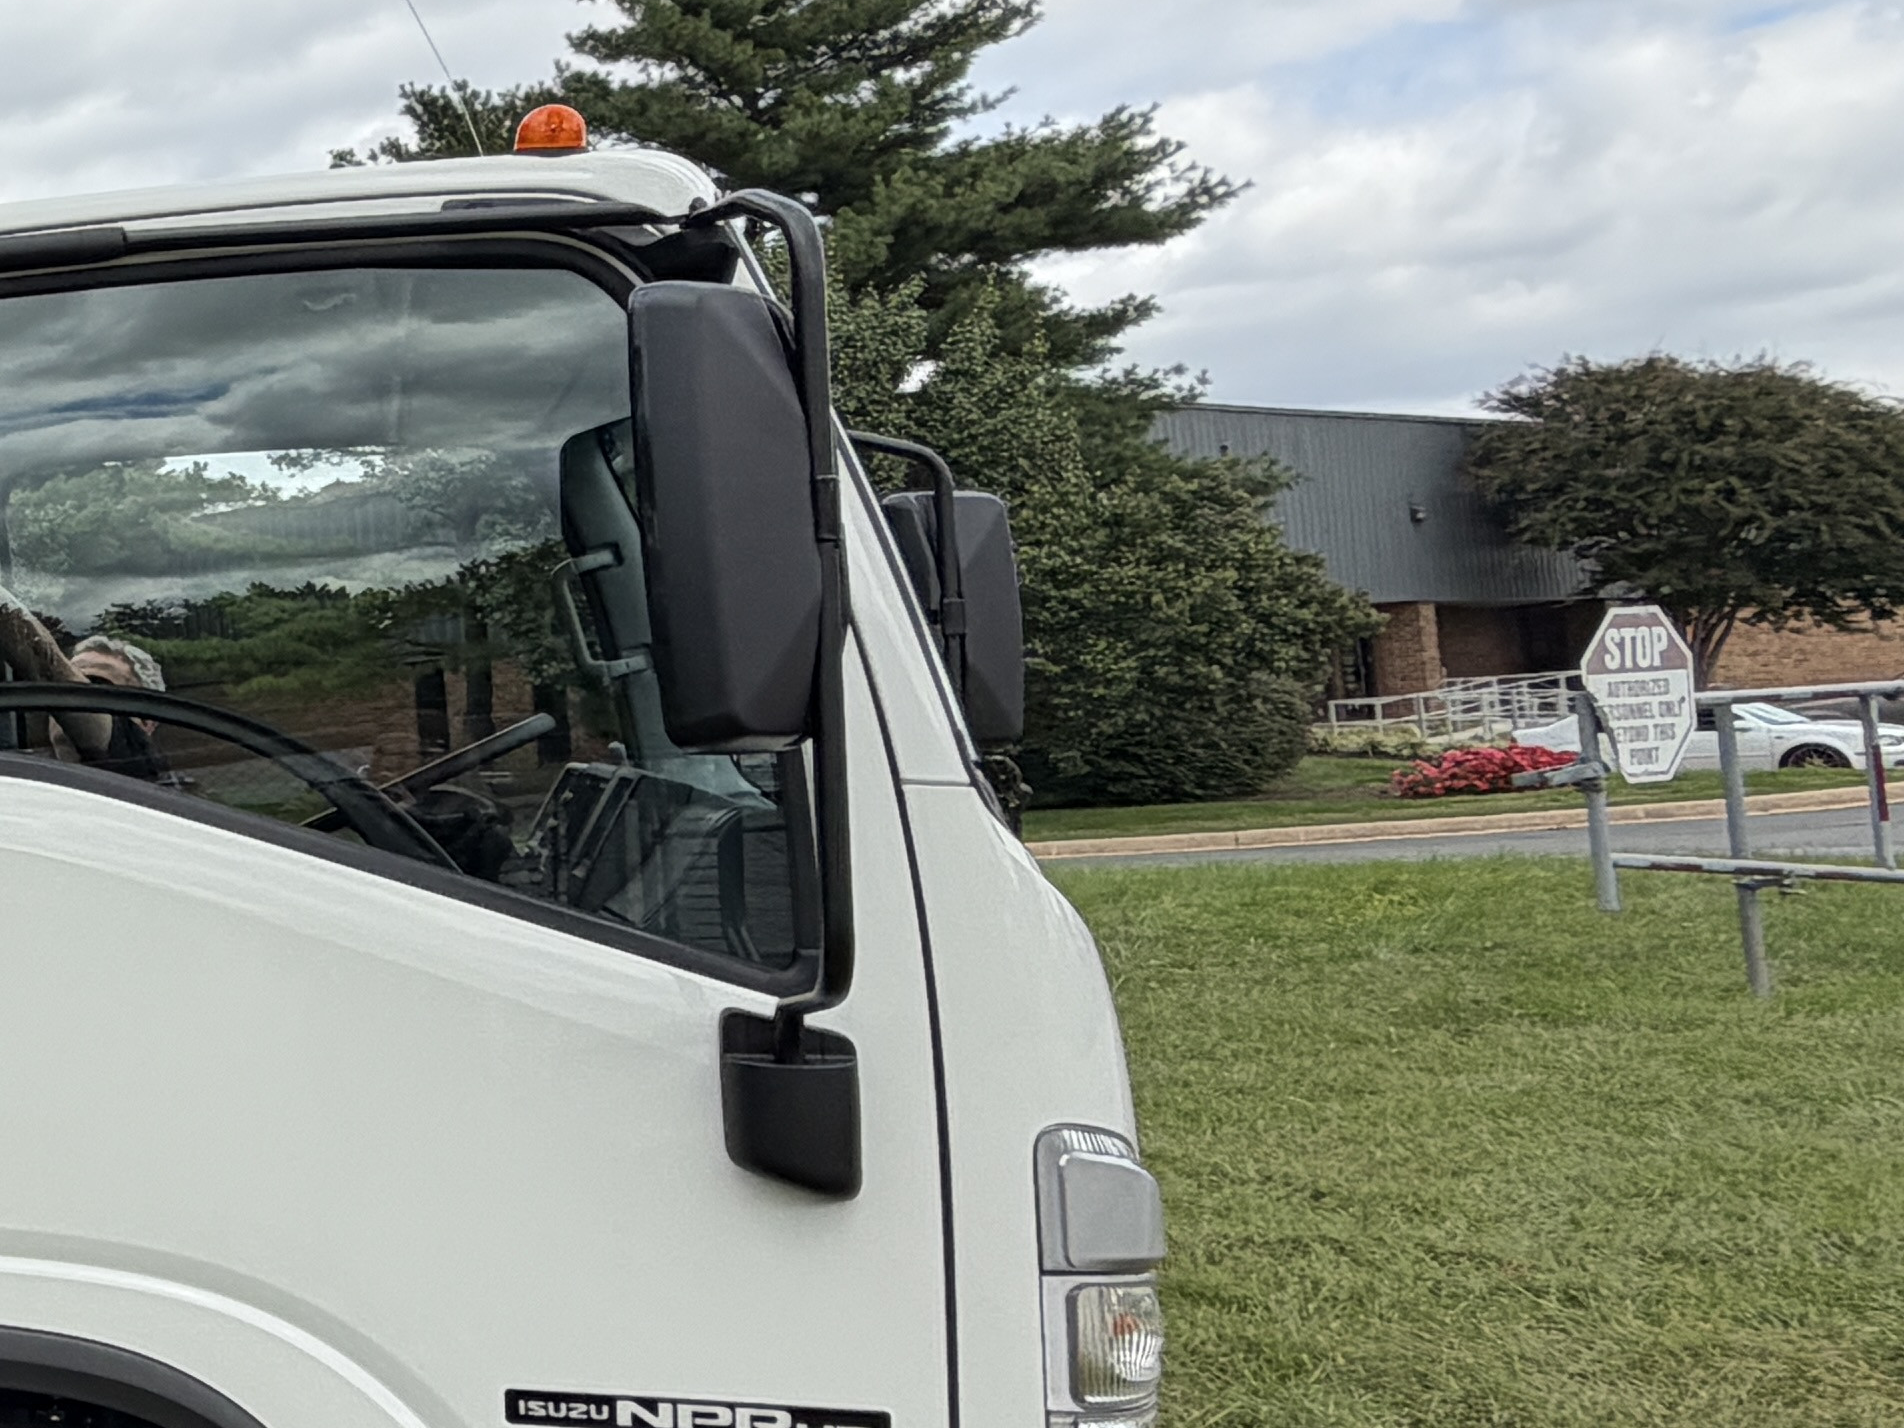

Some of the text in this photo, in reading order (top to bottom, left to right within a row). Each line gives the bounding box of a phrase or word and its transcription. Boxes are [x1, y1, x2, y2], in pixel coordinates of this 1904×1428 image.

[1604, 626, 1667, 669] STOP
[1607, 678, 1670, 698] AUTHORIZED
[518, 1398, 610, 1421] ISUZU
